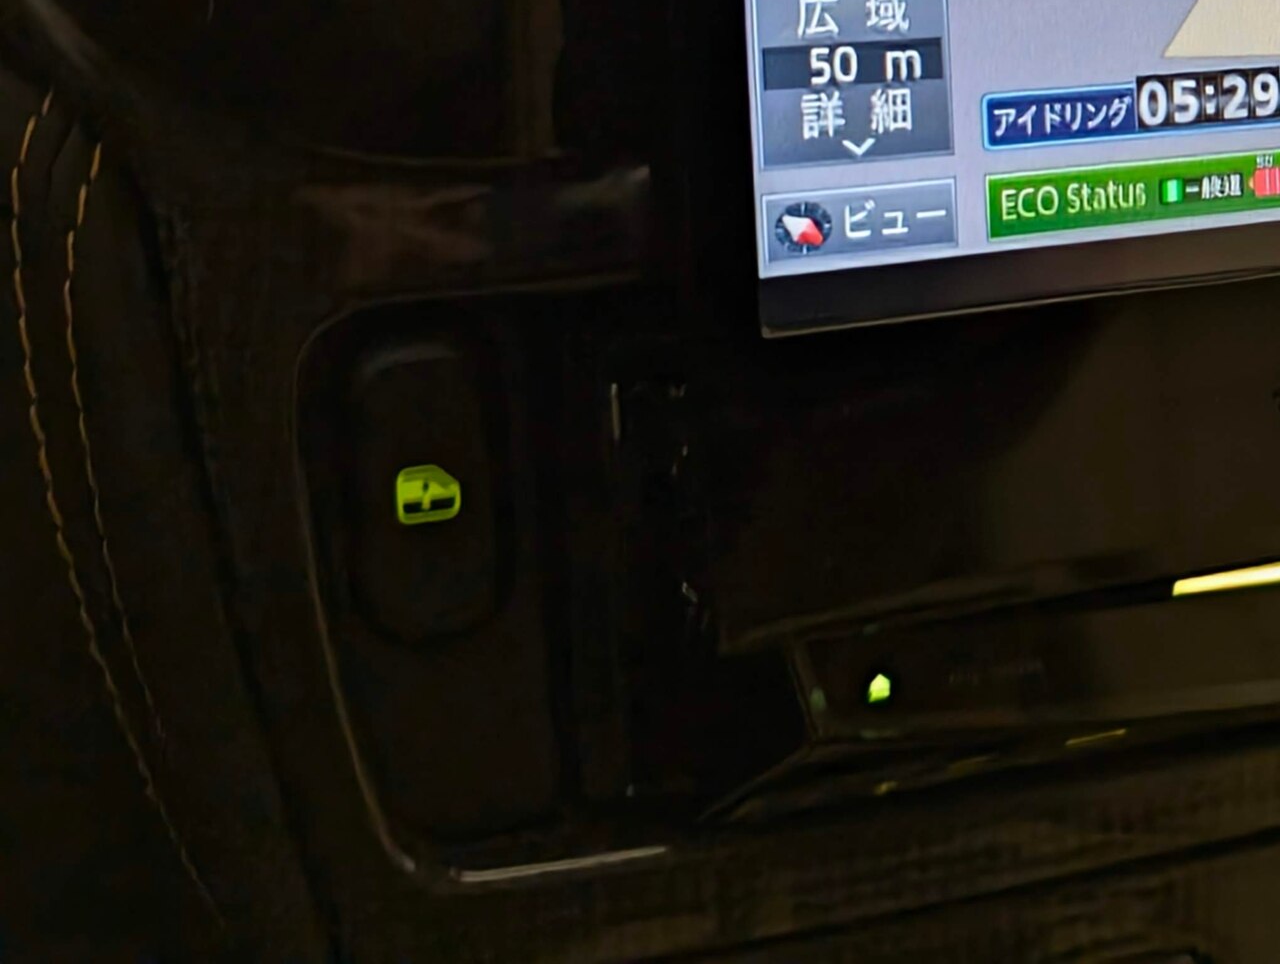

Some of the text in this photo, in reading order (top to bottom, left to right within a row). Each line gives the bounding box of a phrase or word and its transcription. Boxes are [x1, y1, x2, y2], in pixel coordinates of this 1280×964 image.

[809, 46, 922, 86] 50 m
[801, 88, 913, 140] 詳細
[993, 95, 1132, 137] アイドリング
[1138, 72, 1280, 127] 05:29
[844, 198, 947, 239] ビュー
[1001, 180, 1147, 221] ECO Status
